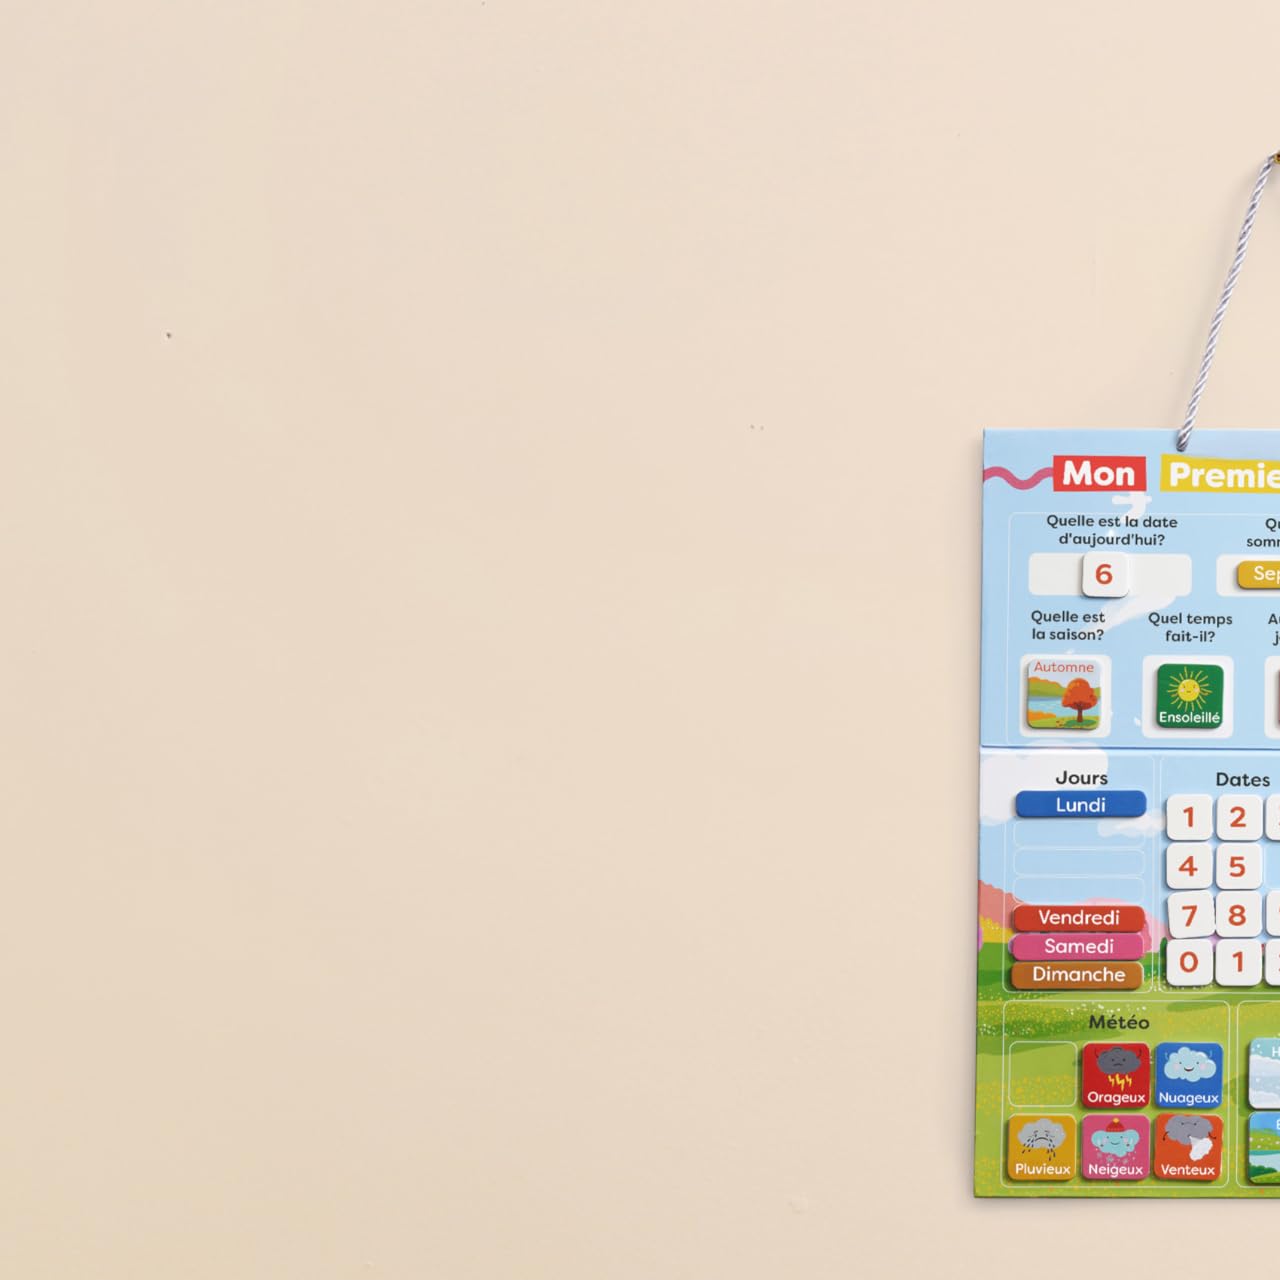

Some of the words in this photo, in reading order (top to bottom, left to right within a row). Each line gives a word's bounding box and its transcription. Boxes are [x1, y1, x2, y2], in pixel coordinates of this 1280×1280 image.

[1063, 460, 1136, 487] Mon
[1046, 514, 1095, 529] Quelle
[1098, 516, 1121, 529] est
[1125, 515, 1139, 528] la
[1141, 515, 1178, 529] date
[1059, 532, 1166, 547] d'aujourd'hui?
[1095, 563, 1113, 585] 6
[1031, 610, 1079, 624] Quelle
[1082, 611, 1106, 624] est
[1148, 612, 1183, 626] Quel
[1187, 613, 1233, 627] temps
[1031, 628, 1046, 640] la
[1049, 629, 1105, 641] saison?
[1165, 630, 1216, 643] fait-il?
[1034, 661, 1096, 674] Automne
[1159, 711, 1220, 724] Ensoleillé
[1054, 771, 1108, 785] Jours
[1215, 772, 1271, 787] Dates
[1056, 797, 1106, 813] Lundi
[1183, 807, 1195, 827] 1
[1229, 808, 1246, 827] 2
[1178, 856, 1198, 877] 4
[1228, 856, 1246, 877] 5
[1038, 909, 1120, 927] Vendredi
[1181, 905, 1198, 926] 7
[1228, 905, 1246, 926] 8
[1044, 938, 1114, 955] Samedi
[1178, 951, 1199, 973] 0
[1232, 952, 1245, 973] 1
[1032, 965, 1127, 983] Dimanche
[1088, 1014, 1150, 1032] Météo
[1087, 1091, 1146, 1106] Orageux
[1158, 1091, 1219, 1107] Nuageux
[1014, 1163, 1071, 1177] Pluvieux
[1087, 1163, 1143, 1178] Neigeux
[1161, 1163, 1215, 1177] Venteux
